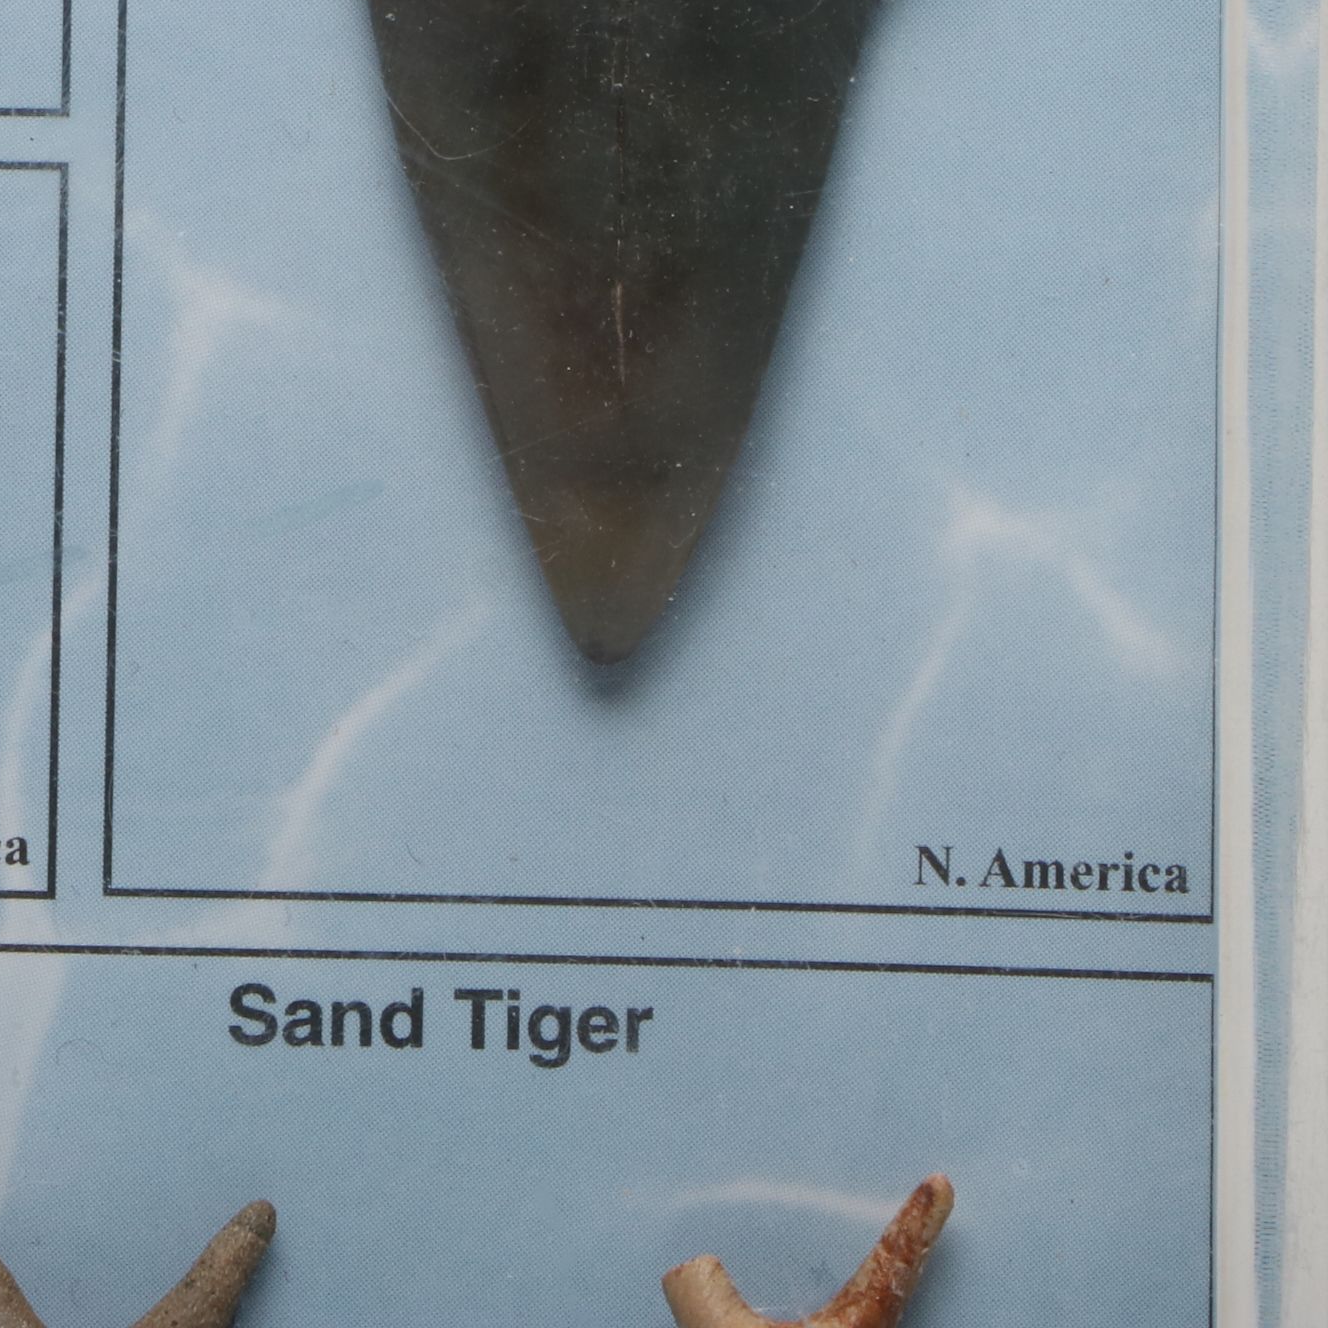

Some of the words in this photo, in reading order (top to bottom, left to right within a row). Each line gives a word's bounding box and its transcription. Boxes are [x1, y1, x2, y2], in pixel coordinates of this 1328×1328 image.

[916, 844, 967, 888] N.
[981, 848, 1190, 896] America
[229, 982, 425, 1049] Sand
[454, 988, 654, 1069] Tiger
